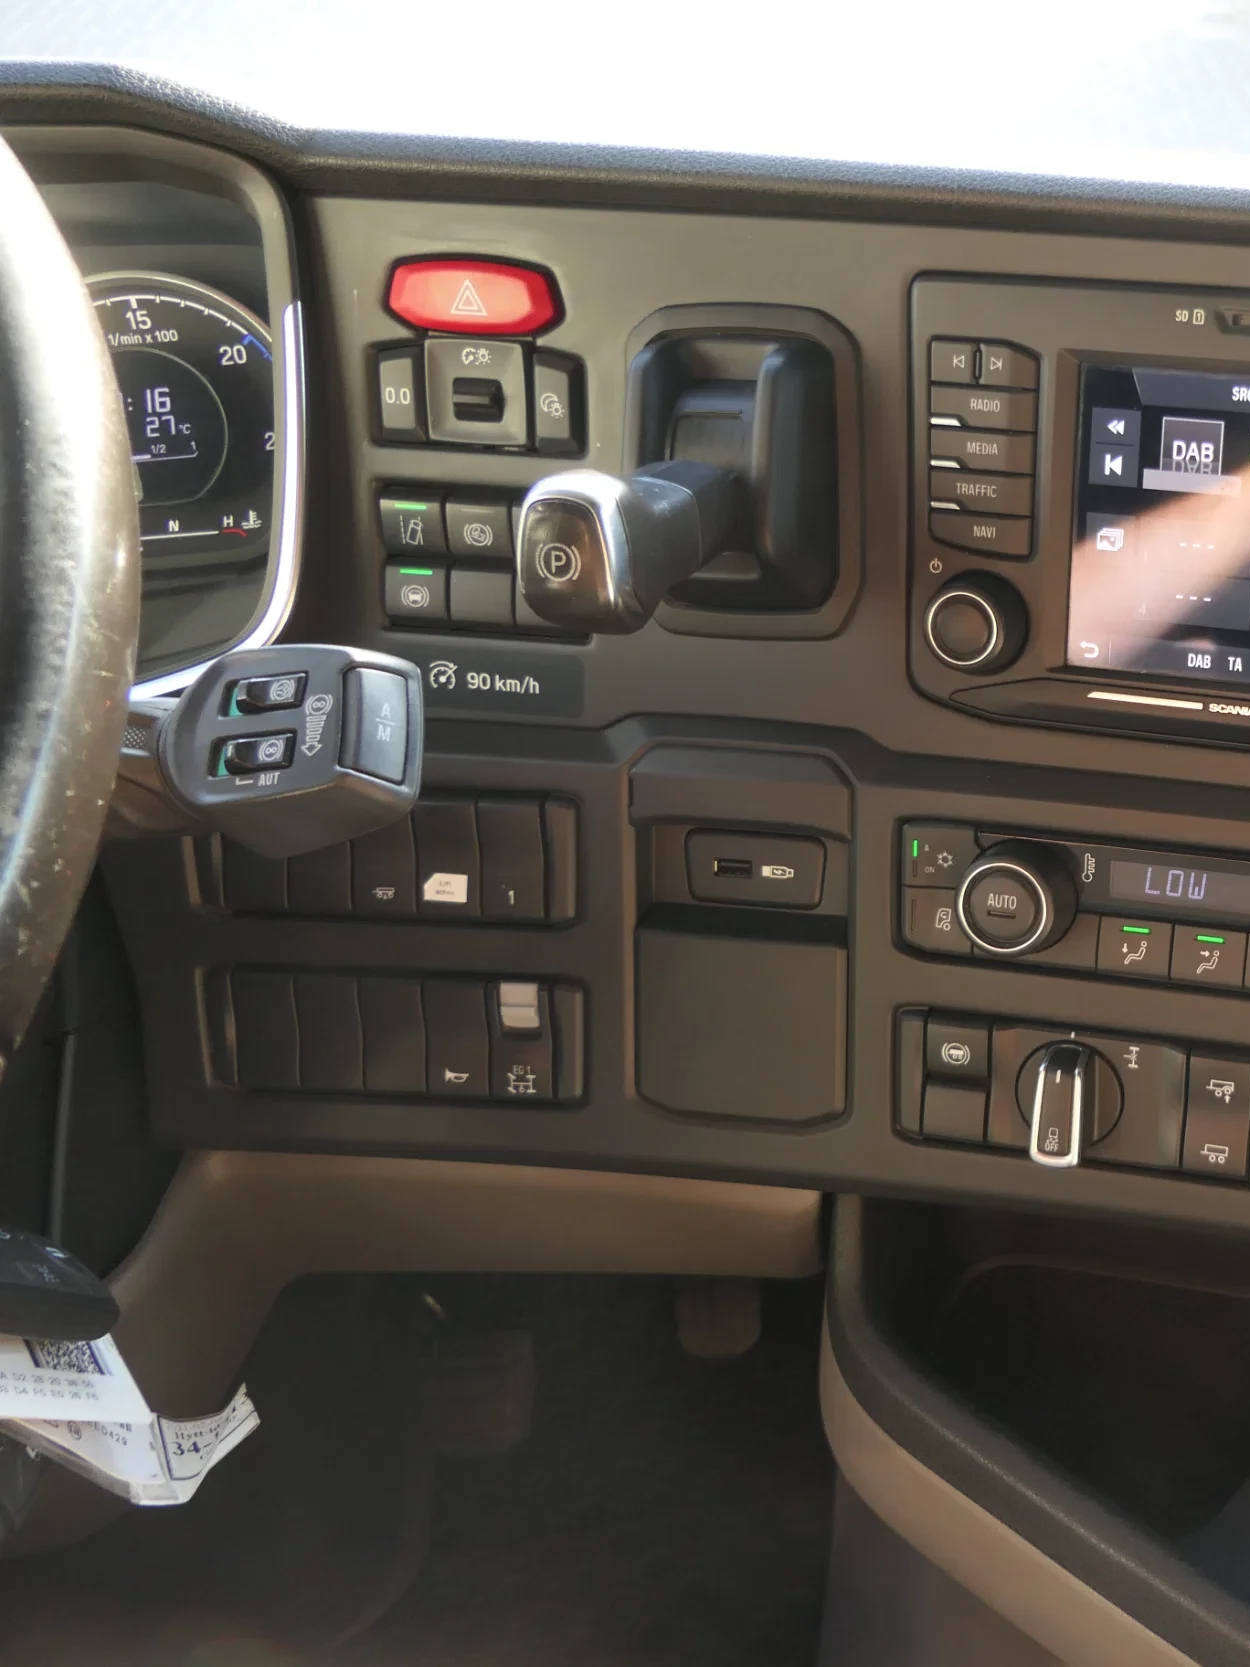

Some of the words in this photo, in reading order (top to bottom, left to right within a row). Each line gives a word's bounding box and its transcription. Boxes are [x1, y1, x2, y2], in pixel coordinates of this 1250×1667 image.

[125, 310, 152, 330] 15
[1175, 309, 1189, 322] SD
[108, 332, 142, 346] 1/min
[154, 330, 178, 344] 100
[219, 346, 247, 366] 20
[385, 387, 411, 404] 0.0
[970, 398, 1000, 413] RADIO
[146, 415, 176, 437] 27
[151, 444, 166, 454] 1/2
[966, 441, 998, 455] MEDIA
[1172, 440, 1215, 463] DAB
[956, 482, 997, 498] TRAFFIC
[168, 520, 179, 533] N
[223, 515, 233, 527] H
[973, 525, 996, 539] NAVI
[551, 550, 567, 574] P
[1187, 653, 1212, 669] DAB
[1227, 656, 1243, 673] TA
[467, 672, 491, 690] 90
[495, 673, 540, 694] km/h
[380, 703, 391, 718] A
[377, 724, 391, 741] M
[1144, 866, 1208, 900] LOW
[508, 890, 515, 905] 1
[987, 892, 1018, 911] AUTO
[1044, 1141, 1060, 1153] OFF
